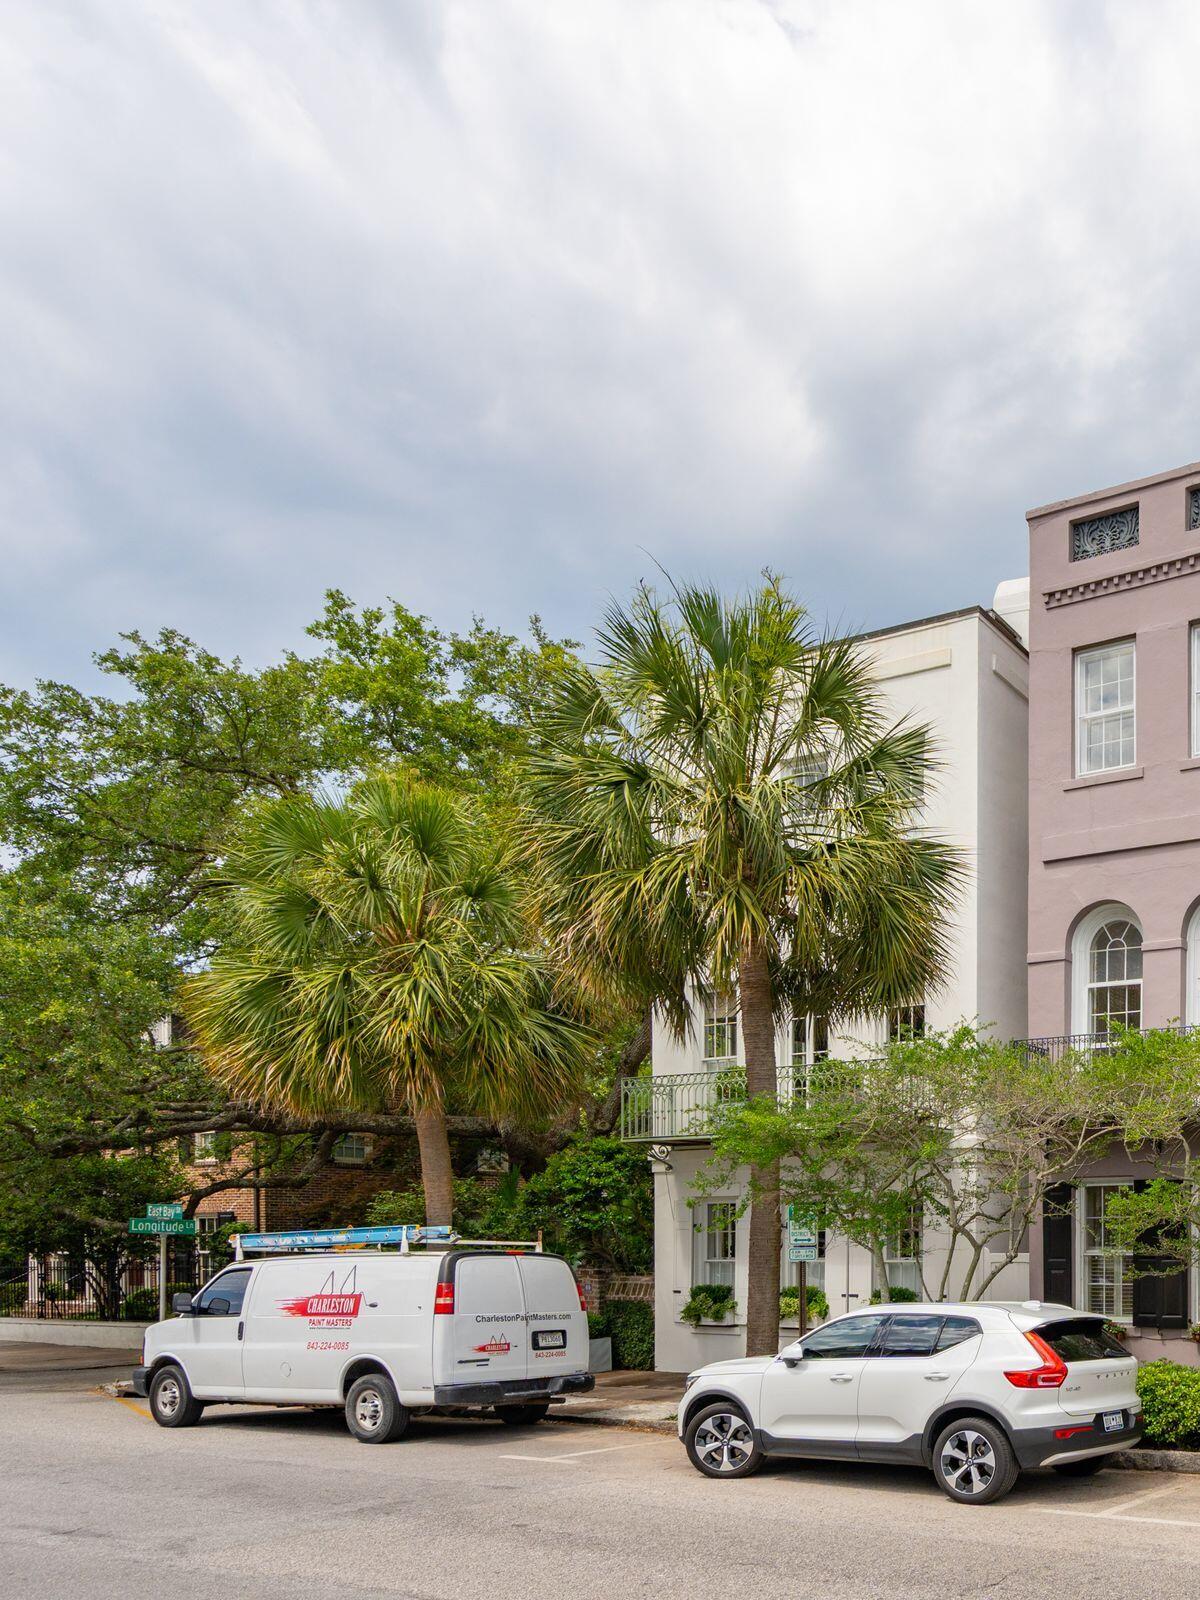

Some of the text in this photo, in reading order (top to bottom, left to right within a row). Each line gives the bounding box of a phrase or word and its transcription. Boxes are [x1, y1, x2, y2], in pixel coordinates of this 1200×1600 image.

[148, 1205, 162, 1217] East
[162, 1206, 174, 1219] Bay
[131, 1219, 194, 1232] Longitude Ln
[307, 1298, 356, 1314] CHARLESTON
[308, 1318, 353, 1327] PAINT MASTERS
[475, 1312, 572, 1323] CharlestonPaintMasters.com
[306, 1341, 350, 1351] 843-224-0085
[535, 1350, 567, 1359] 843-224-0085
